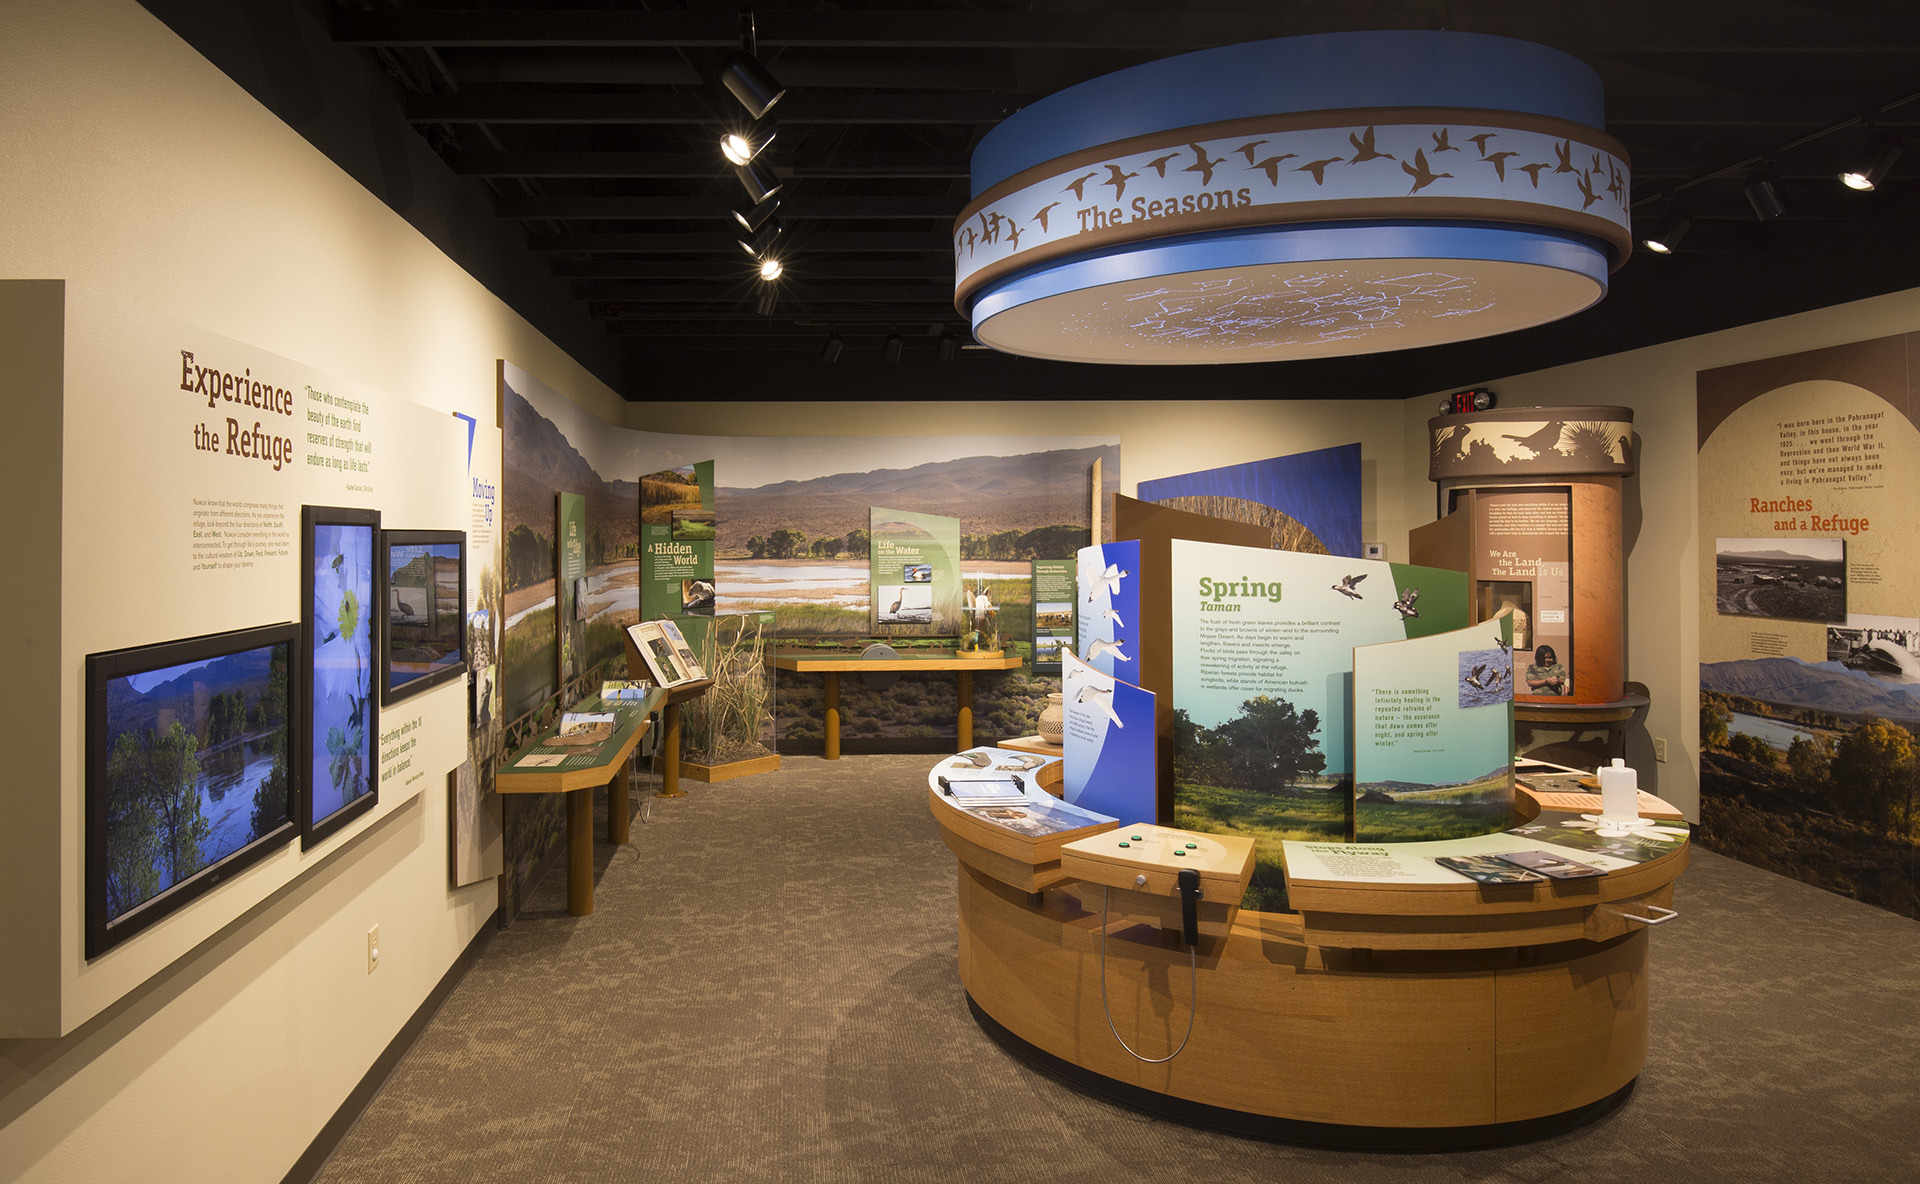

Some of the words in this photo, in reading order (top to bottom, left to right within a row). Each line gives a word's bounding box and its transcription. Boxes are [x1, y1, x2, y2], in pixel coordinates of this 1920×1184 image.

[1076, 204, 1122, 233] The
[1131, 188, 1251, 222] Seasons
[181, 350, 292, 416] Experience
[334, 396, 361, 414] contemplate
[1457, 392, 1474, 412] EXIT
[306, 408, 324, 426] beauty
[340, 418, 352, 430] earth
[1848, 411, 1884, 421] Pahranagat
[1865, 423, 1878, 431] year
[194, 423, 219, 452] the
[226, 418, 292, 471] Refuge
[306, 432, 328, 446] reserves
[335, 436, 354, 452] strength
[1836, 434, 1860, 443] through
[1780, 449, 1811, 458] Depression
[306, 452, 324, 466] endure
[332, 456, 342, 472] long
[1827, 464, 1854, 474] managed
[1866, 463, 1882, 472] make
[1812, 476, 1846, 485] Pahranagat
[473, 477, 495, 505] Moving
[1750, 496, 1812, 512] Ranches
[485, 504, 492, 526] Up
[1774, 518, 1796, 530] and
[1800, 521, 1807, 530] a
[1811, 515, 1869, 535] Refuge
[655, 543, 692, 554] Hidden
[878, 541, 894, 549] Life
[673, 555, 698, 565] World
[1515, 558, 1545, 567] Land,
[1509, 567, 1536, 576] Land
[1539, 568, 1548, 576] is
[1200, 576, 1282, 603] Spring
[1200, 601, 1241, 612] Taman
